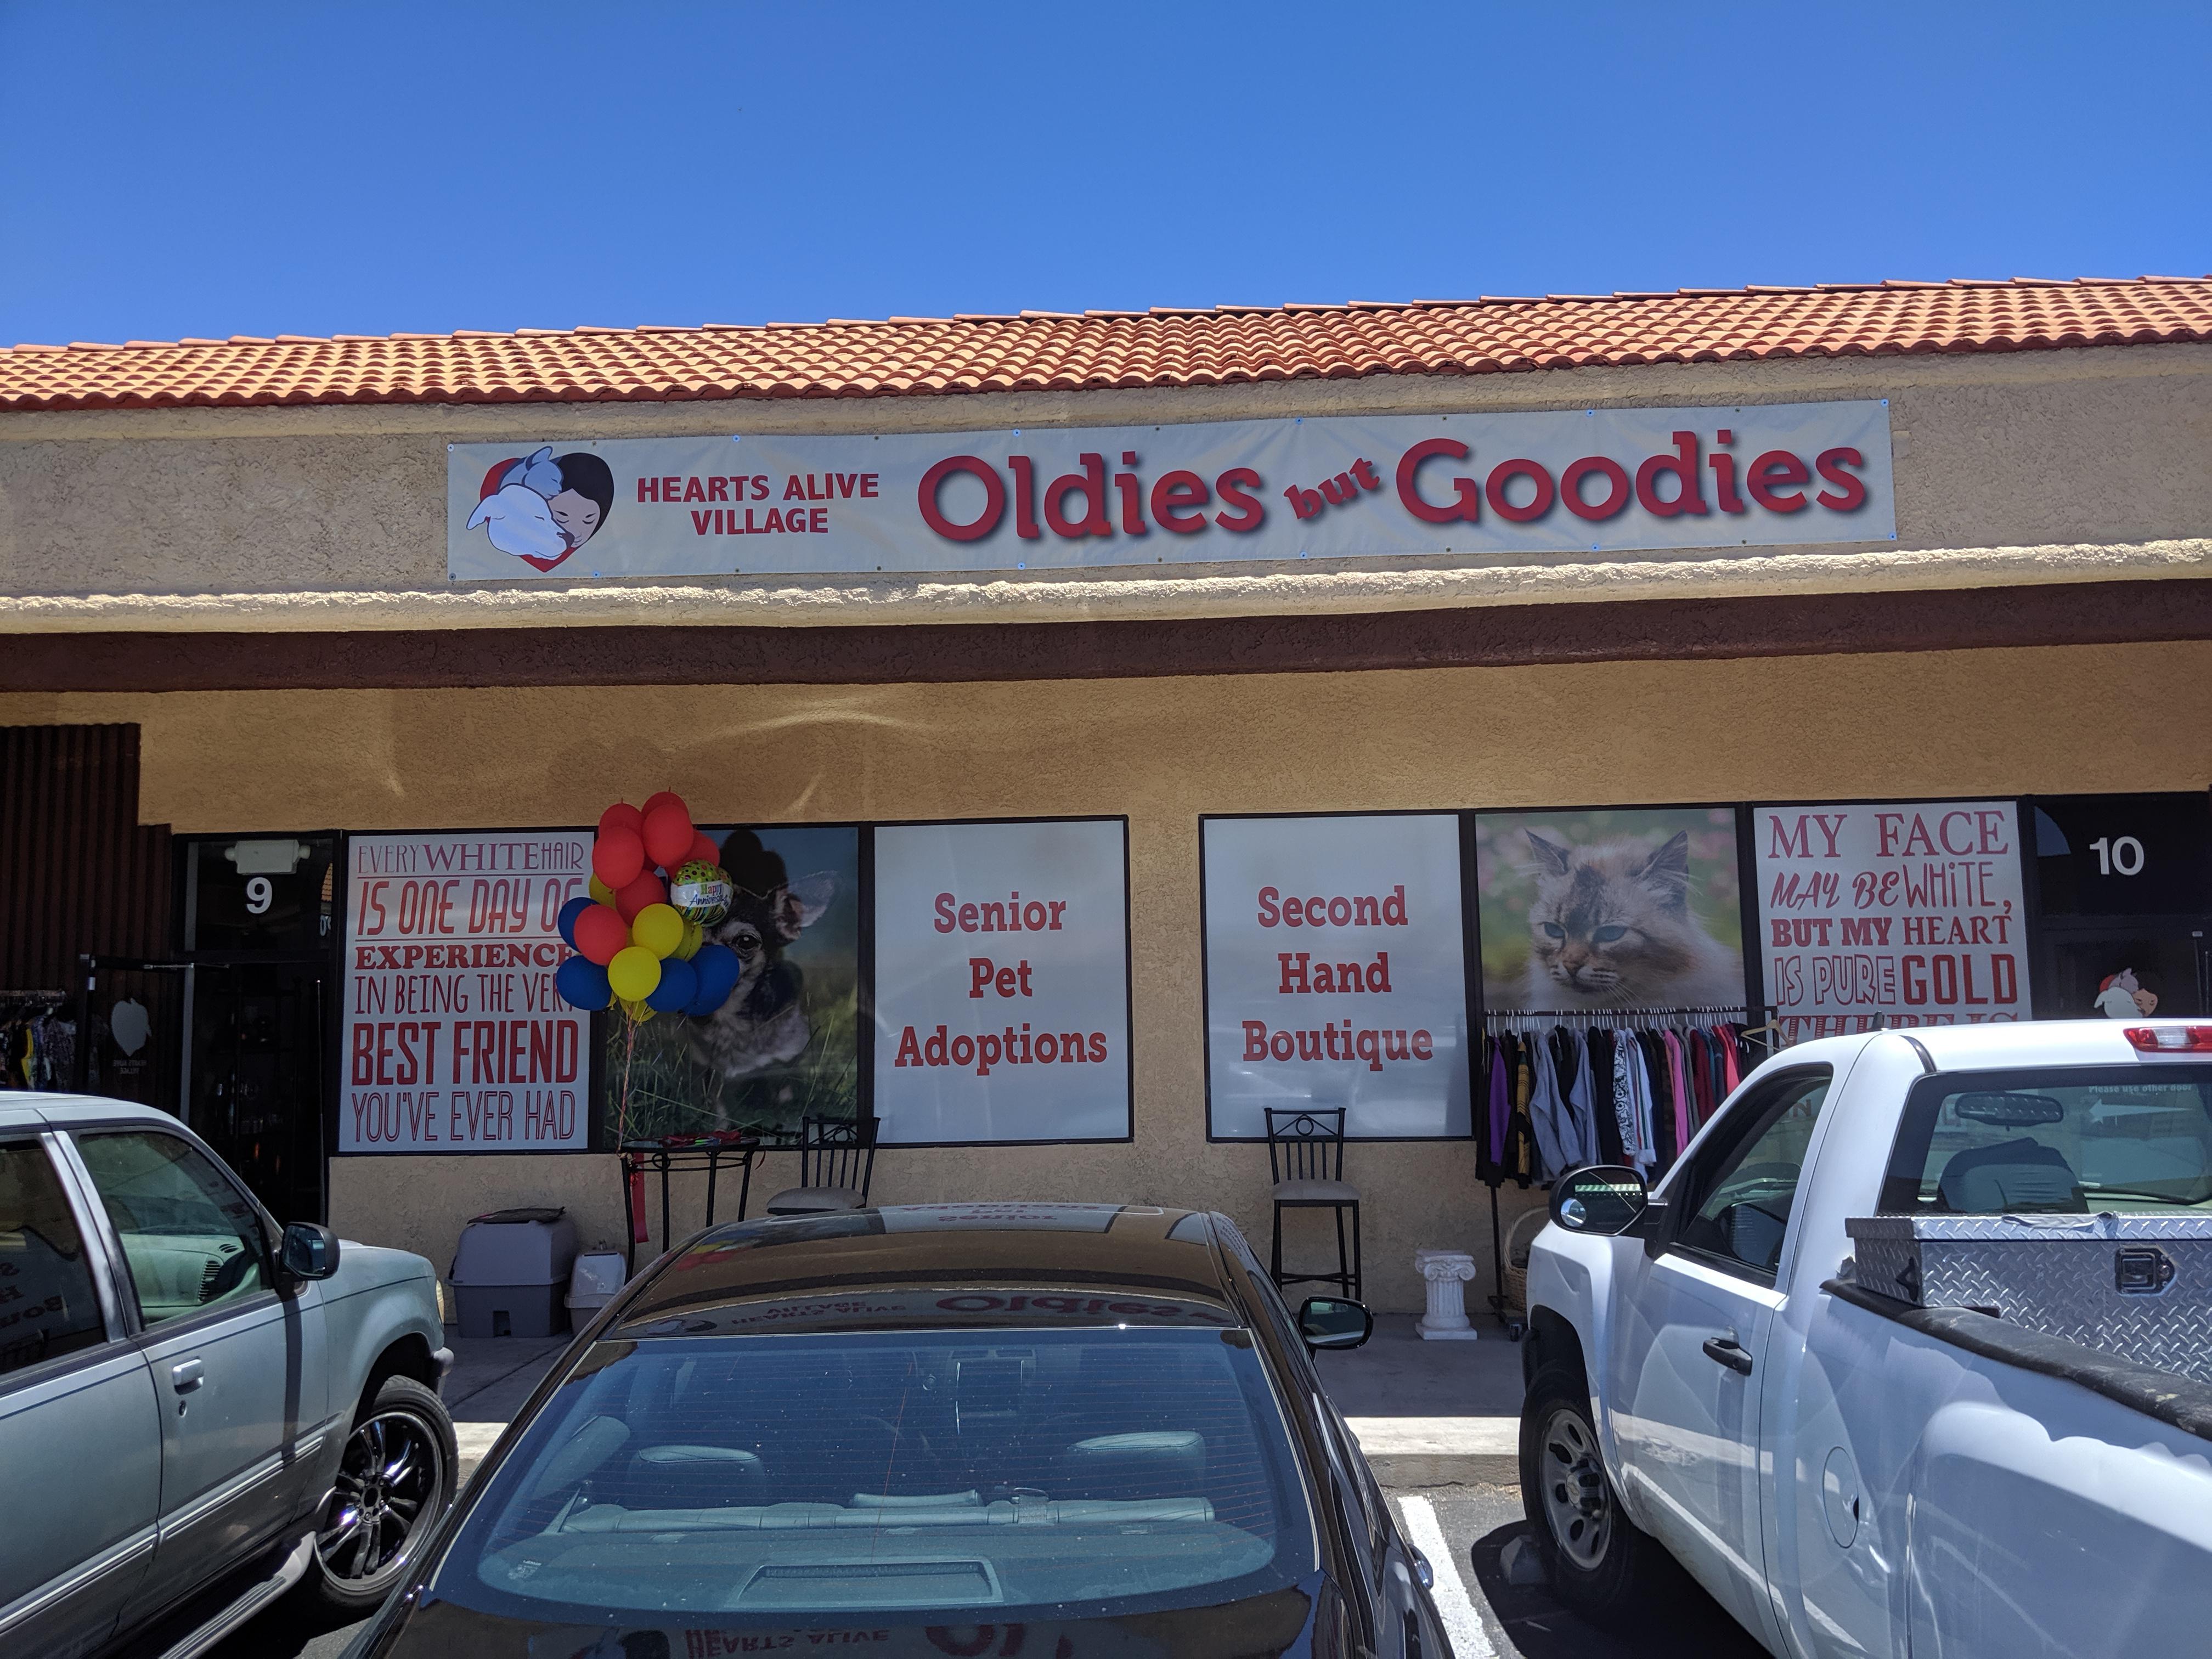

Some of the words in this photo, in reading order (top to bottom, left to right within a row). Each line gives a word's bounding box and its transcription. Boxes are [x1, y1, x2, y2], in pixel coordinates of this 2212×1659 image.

[637, 475, 769, 503] HEARTS
[783, 473, 878, 500] ALIVE
[918, 451, 1265, 541] Oldies
[1284, 458, 1380, 520] but
[1396, 430, 1864, 522] Goodies
[691, 507, 828, 535] VILLAGE
[1768, 814, 1847, 859] MY
[1875, 810, 2008, 857] FACE
[358, 845, 420, 873] EVERY
[422, 843, 539, 871] WHITE
[541, 842, 584, 870] HAIR
[2089, 836, 2145, 876] 10
[246, 877, 273, 914] 9
[358, 881, 389, 935] IS
[398, 879, 460, 934] ONE
[469, 878, 532, 933] DAY
[701, 884, 723, 896] Happy
[1257, 885, 1408, 928] Second
[1770, 871, 1840, 910] MAY
[1852, 871, 1900, 910] BE
[934, 891, 1066, 933] Senior
[1771, 918, 1832, 947] BUT
[1841, 917, 1892, 946] MY
[1902, 916, 2012, 946] HEART
[354, 975, 387, 1014] IN
[394, 974, 468, 1014] BEING
[477, 973, 515, 1013] THE
[522, 972, 573, 1013] VER
[969, 958, 1032, 998] Pet
[1278, 952, 1392, 994] Hand
[1775, 955, 1804, 1006] IS
[1813, 954, 1896, 1006] PURE
[1902, 954, 2017, 1006] GOLD
[352, 1022, 441, 1086] BEST
[453, 1020, 578, 1084] FRIEND
[895, 1023, 1107, 1076] Adoptions
[1242, 1019, 1433, 1071] Boutique
[352, 1092, 439, 1142] YOU'VE
[450, 1091, 513, 1141] EVER
[525, 1090, 575, 1140] HAD
